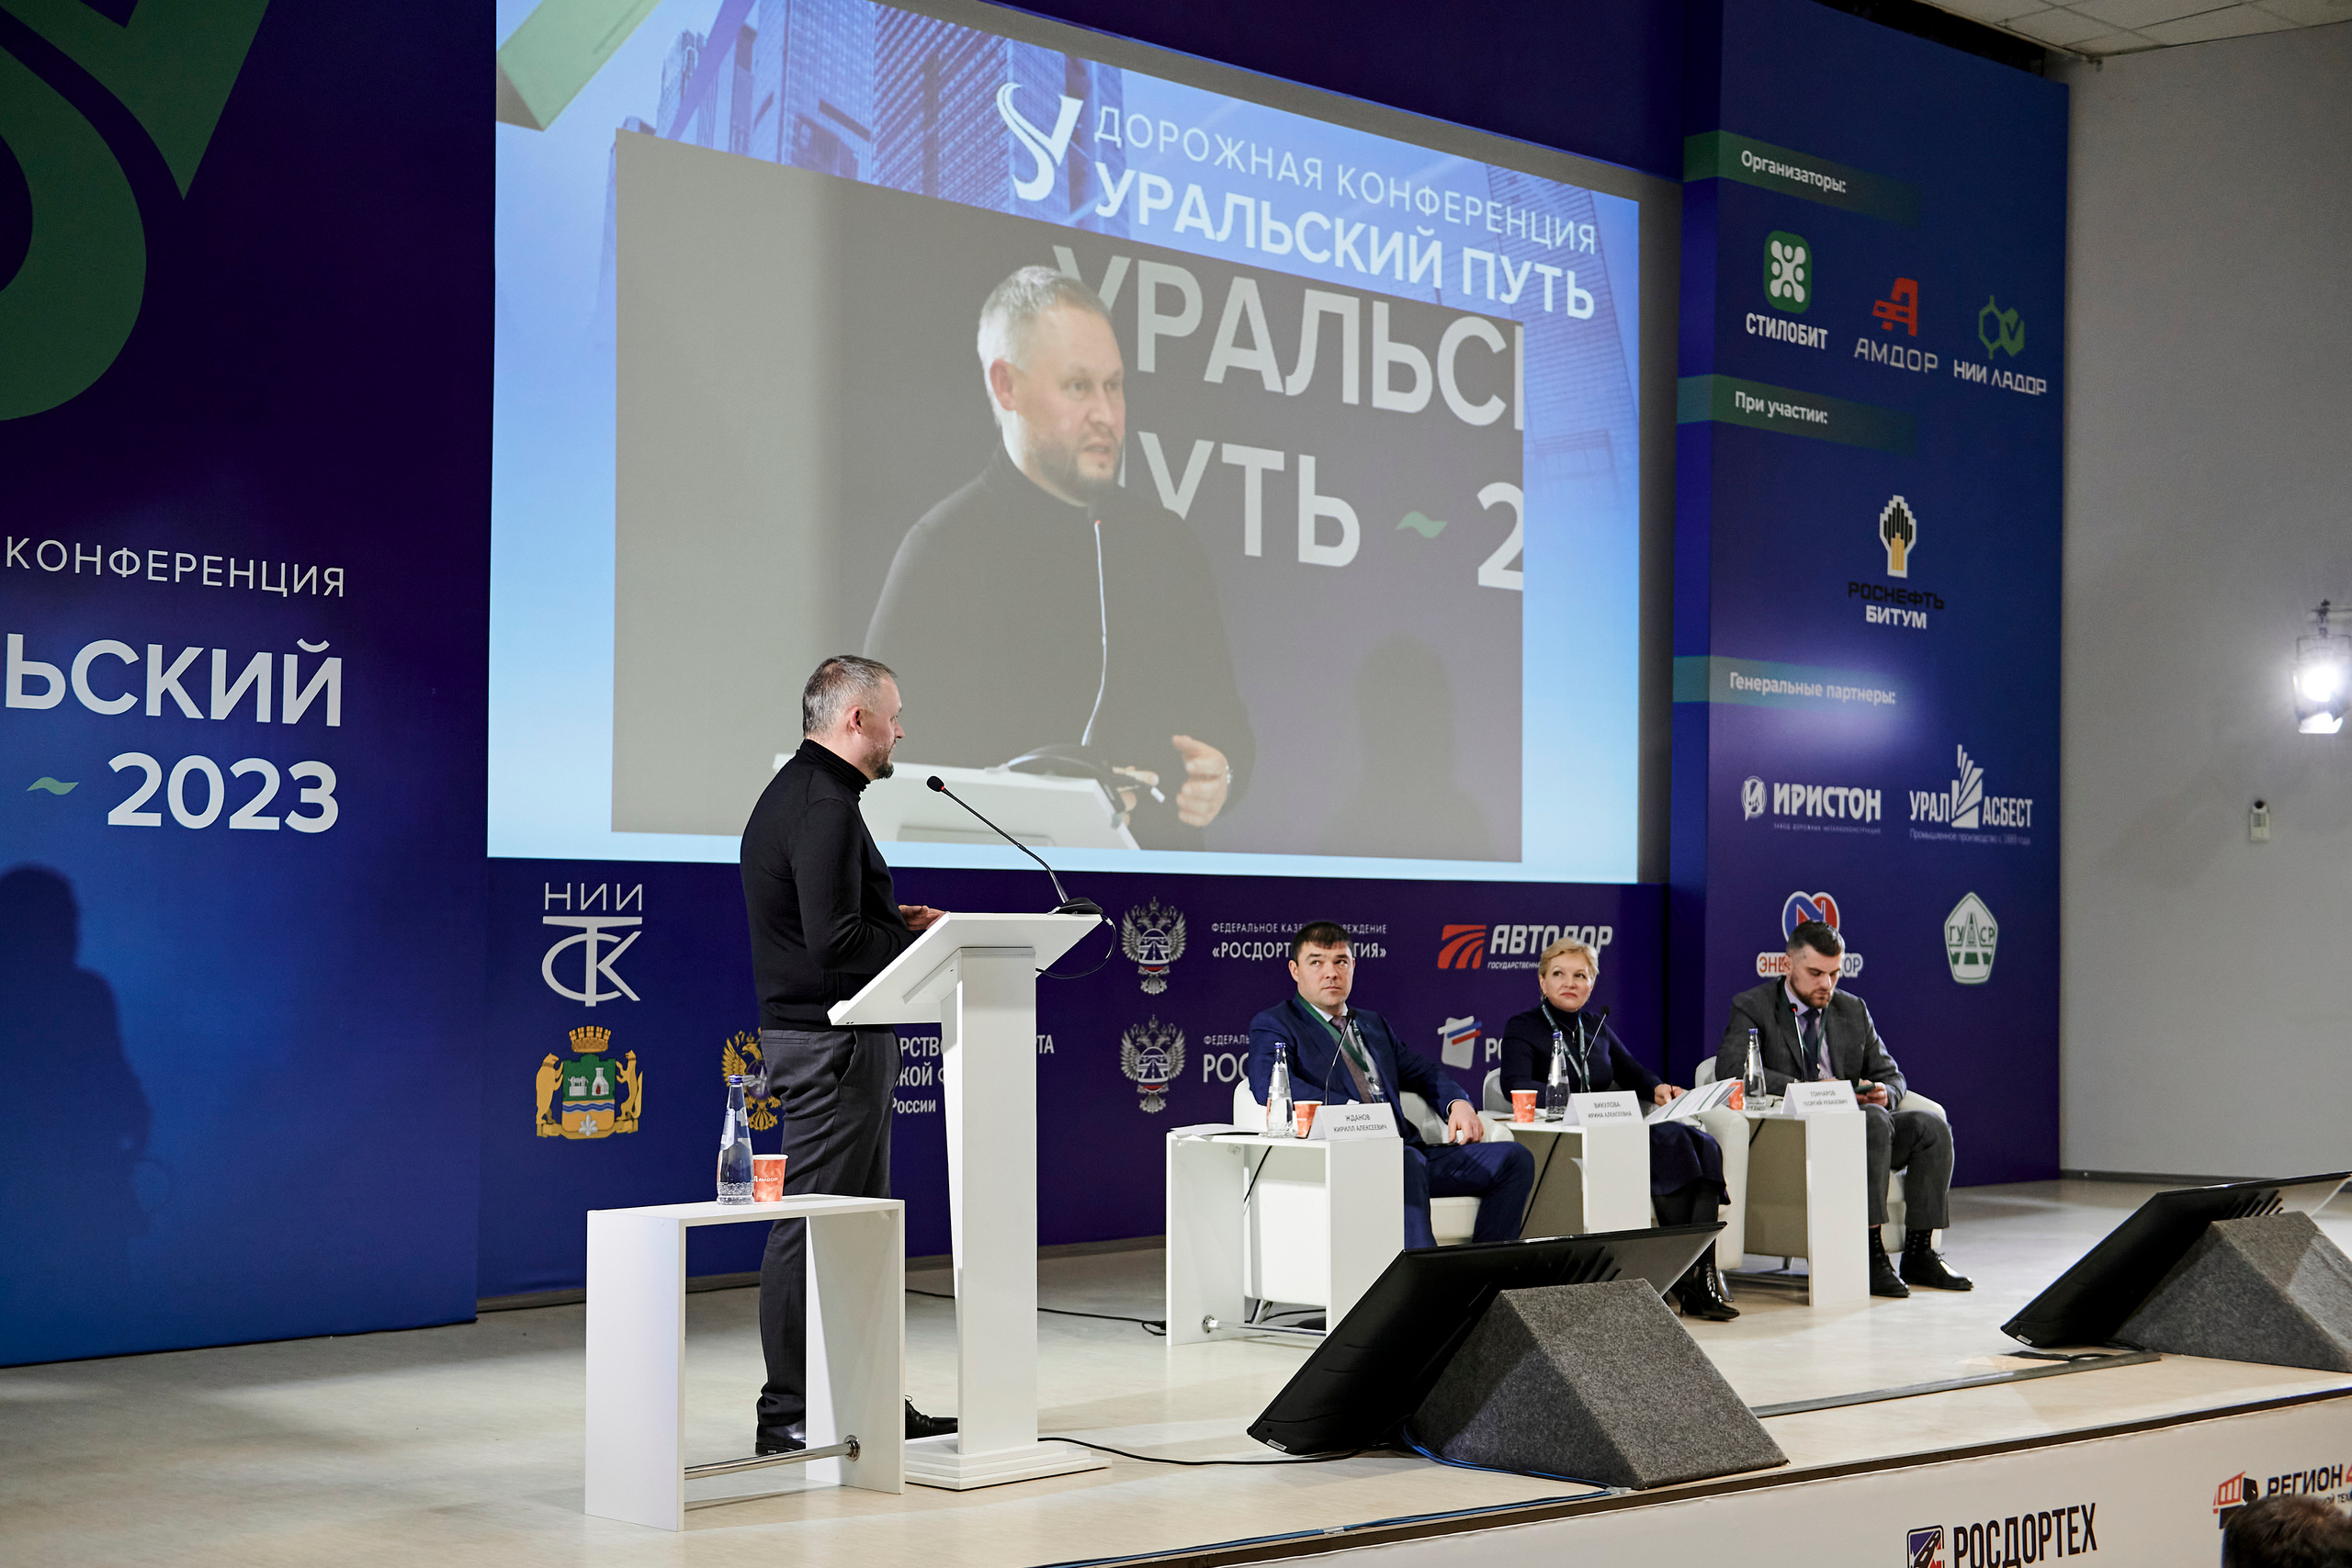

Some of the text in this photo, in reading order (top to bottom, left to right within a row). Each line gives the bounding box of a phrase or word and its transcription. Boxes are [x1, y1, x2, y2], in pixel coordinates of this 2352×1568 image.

[1093, 105, 1597, 255] ДОРОЖНАЯ КОНФЕРЕНЦИЯ
[1741, 150, 1847, 194] Организаторы:
[1093, 160, 1596, 321] УРАЛЬСКИЙ ПУТЬ
[1052, 244, 1523, 431] УРАЛЬС
[1746, 312, 1828, 351] СТИЛОБИТ
[1854, 337, 1939, 374] АМДОР
[1953, 359, 1987, 385] НИИ
[1735, 391, 1828, 425] При участии:
[1118, 429, 1362, 568] УТЬ
[5, 536, 345, 598] КОНФЕРЕНЦИЯ
[1848, 581, 1945, 611] РОСНЕФТЬ
[1865, 604, 1928, 630] БИТУМ
[5, 633, 343, 728] ЬСКИЙ
[1730, 671, 1896, 706] Генеральные партнеры:
[107, 752, 339, 833] 2023
[1773, 782, 1882, 823] ИРИСТОН
[1909, 790, 2033, 828] УРАЛ АСБЕСТ
[544, 882, 643, 911] НИИ
[1211, 922, 1278, 934] ФЕДЕРАЛЬНОЕ
[1345, 1113, 1371, 1122] ЖДАНОВ
[2267, 1463, 2344, 1496] РЕГИОН
[1953, 1502, 2098, 1568] РОСДОРТЕХ
